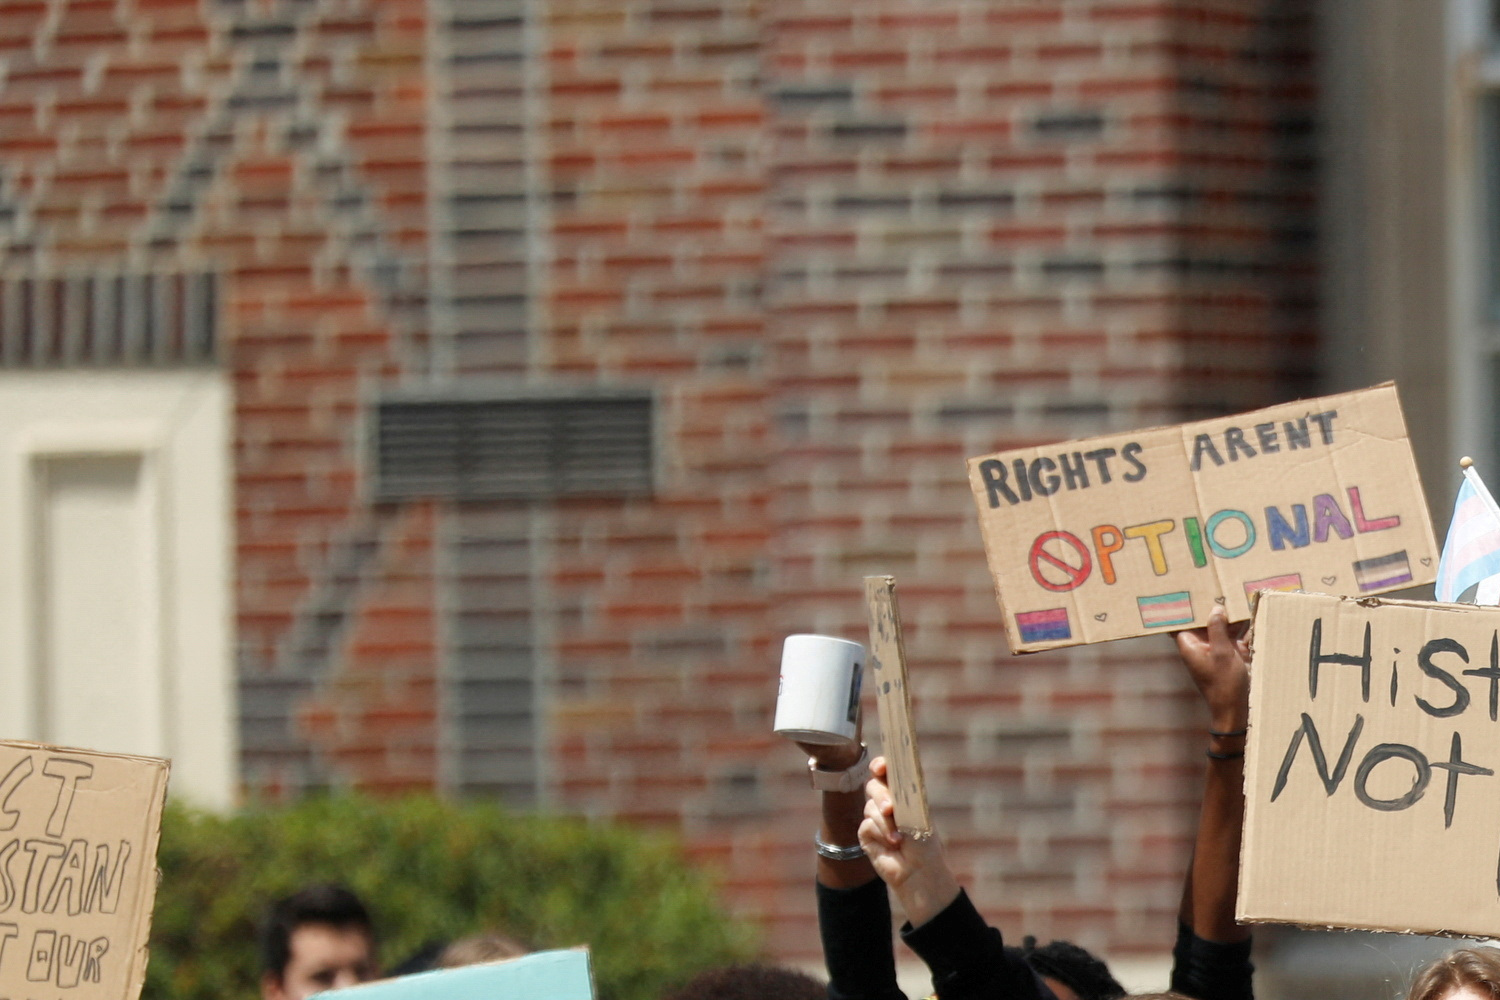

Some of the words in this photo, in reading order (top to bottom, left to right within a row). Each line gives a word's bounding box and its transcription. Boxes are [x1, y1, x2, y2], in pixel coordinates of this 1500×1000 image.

[979, 441, 1147, 509] RIGHTS
[1028, 486, 1400, 592] OPTIONAL
[0, 755, 94, 838] CT
[0, 838, 131, 916] STAN
[26, 930, 109, 989] OUR
